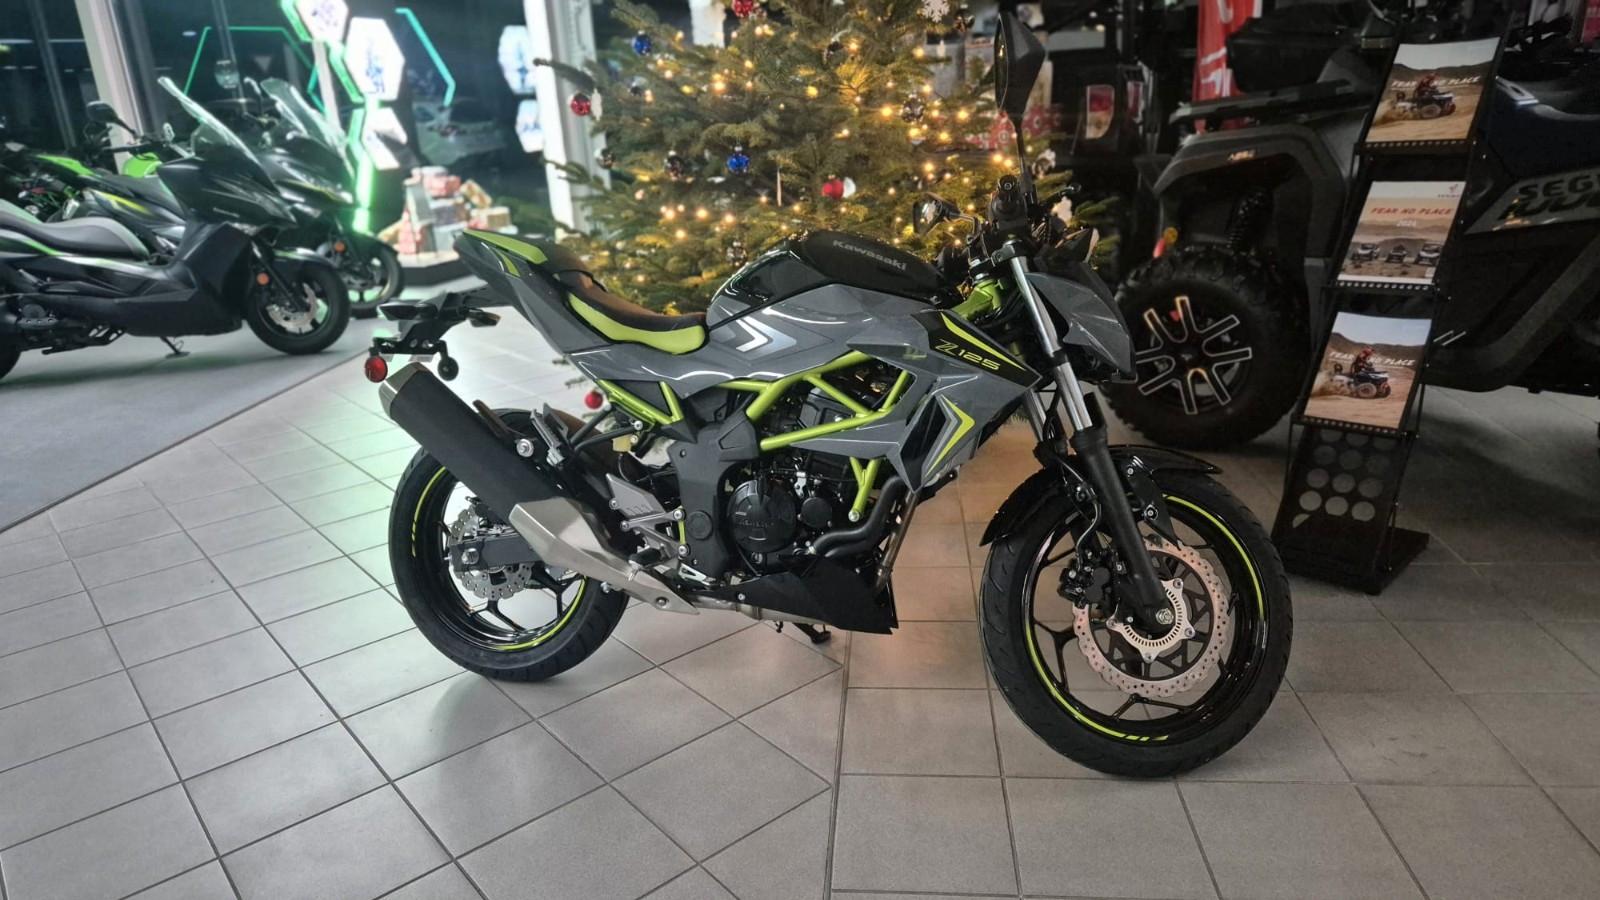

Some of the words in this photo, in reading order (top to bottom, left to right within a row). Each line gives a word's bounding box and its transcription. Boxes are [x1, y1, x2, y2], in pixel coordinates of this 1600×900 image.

[1447, 76, 1481, 85] PLACE
[1519, 174, 1600, 201] SEG
[833, 239, 907, 271] Kawasaki
[1329, 352, 1355, 360] FEAR
[1384, 357, 1416, 366] PLACE
